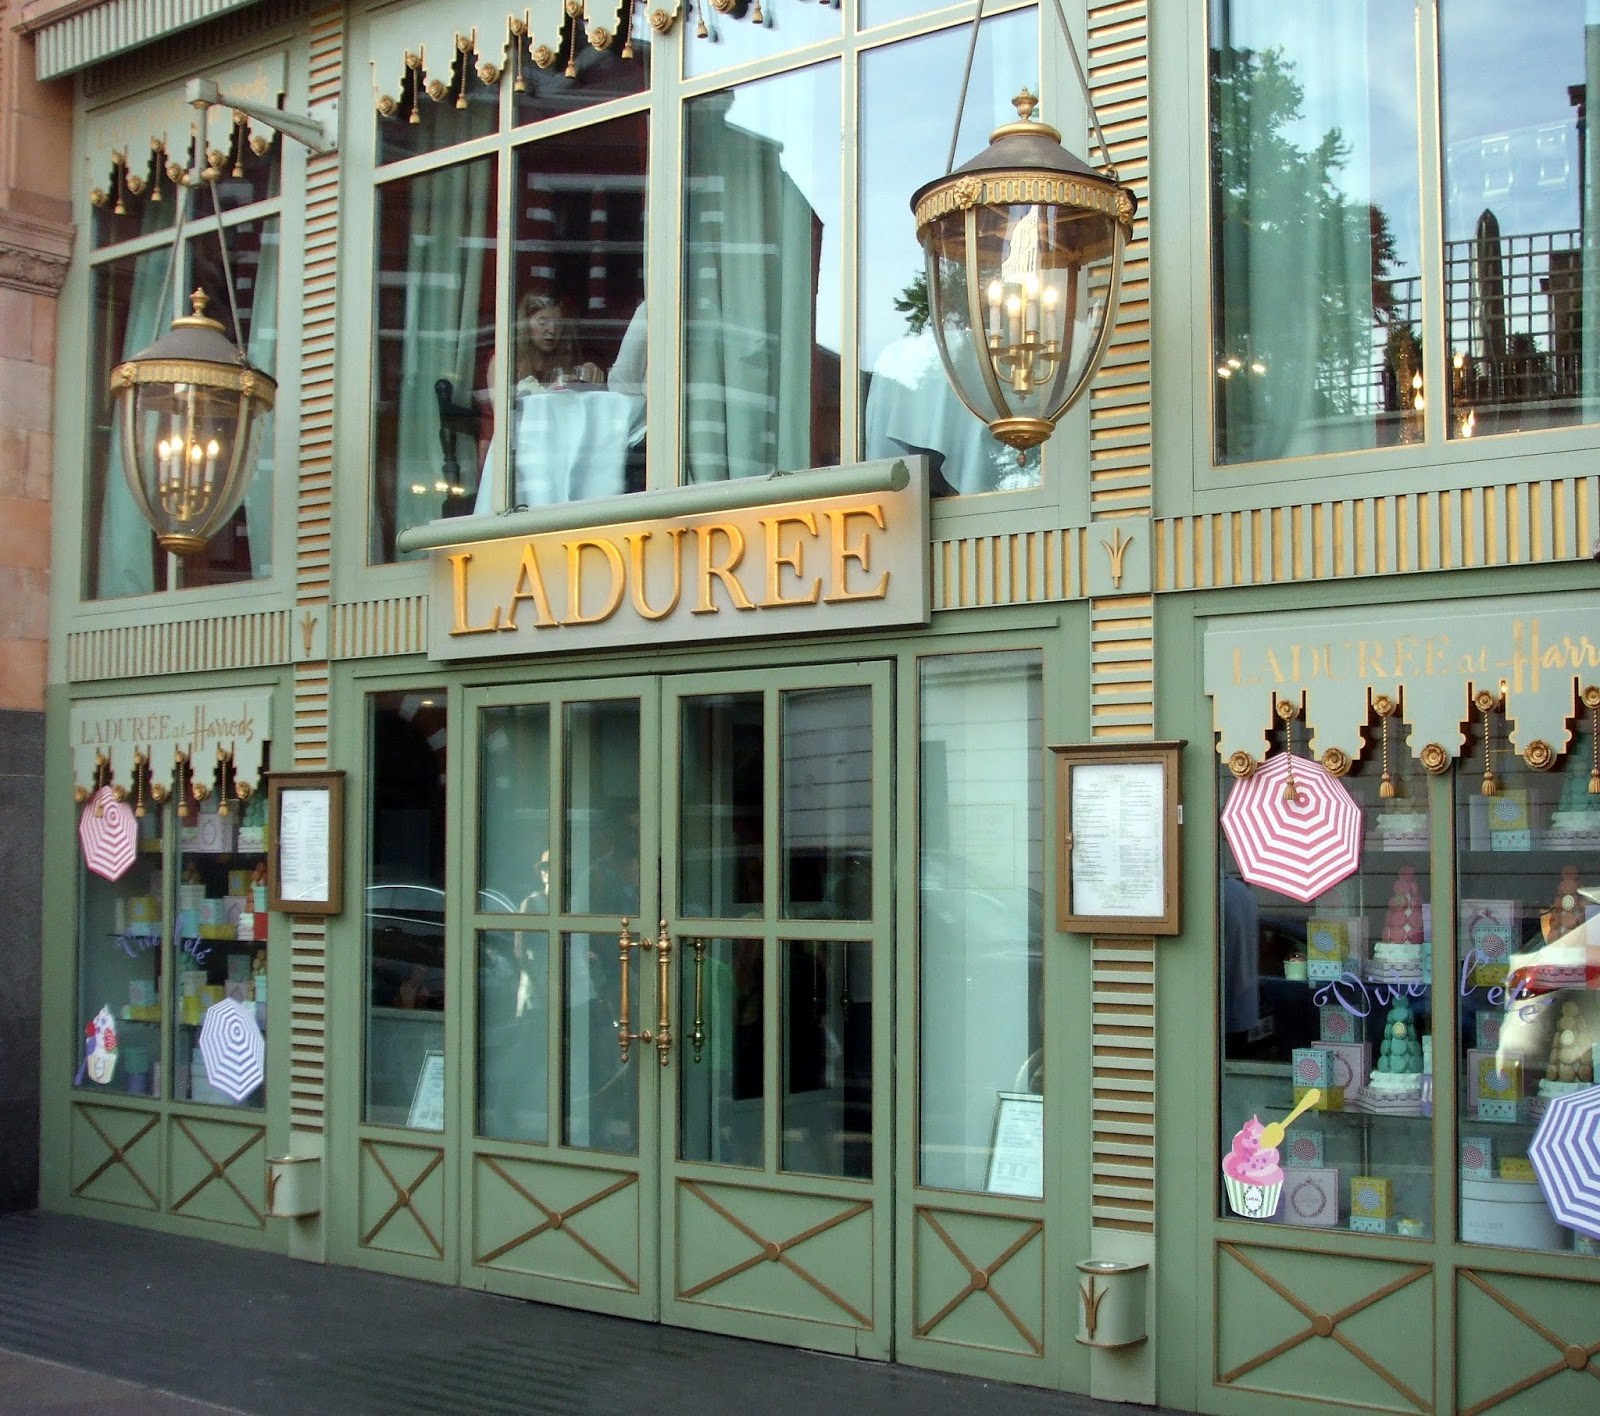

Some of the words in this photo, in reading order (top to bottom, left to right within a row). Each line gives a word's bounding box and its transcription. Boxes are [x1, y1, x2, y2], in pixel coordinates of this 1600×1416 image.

[1457, 643, 1488, 673] at
[1496, 617, 1600, 694] Harr
[187, 702, 254, 752] Harrods
